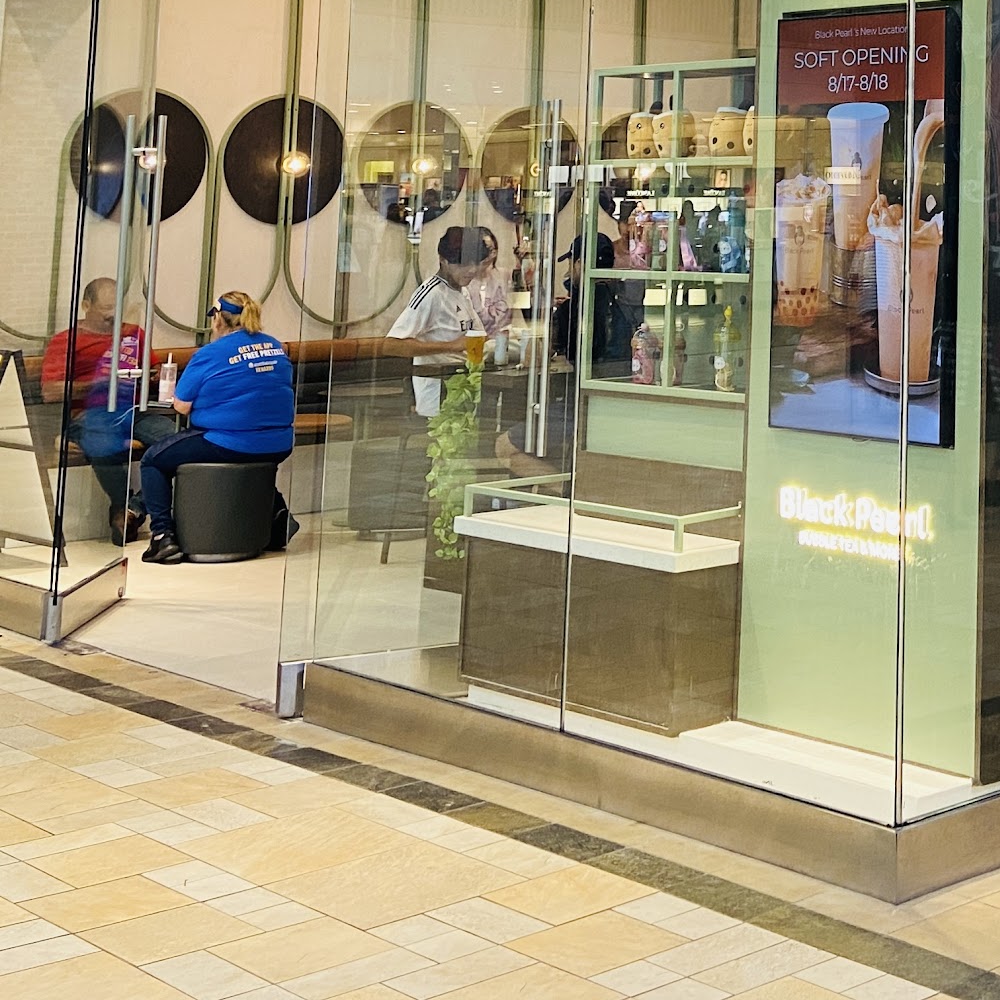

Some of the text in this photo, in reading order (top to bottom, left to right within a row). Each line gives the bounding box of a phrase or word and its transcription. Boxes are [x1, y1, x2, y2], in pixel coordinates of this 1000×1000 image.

[815, 29, 834, 39] Black
[835, 28, 853, 38] Pearl
[860, 27, 878, 36] New
[794, 44, 930, 69] SOFT OPENING
[828, 71, 889, 94] 8/17-8/18
[228, 355, 242, 365] GET
[242, 351, 260, 361] FREE
[238, 346, 251, 354] GET
[779, 486, 934, 542] Black Pearl
